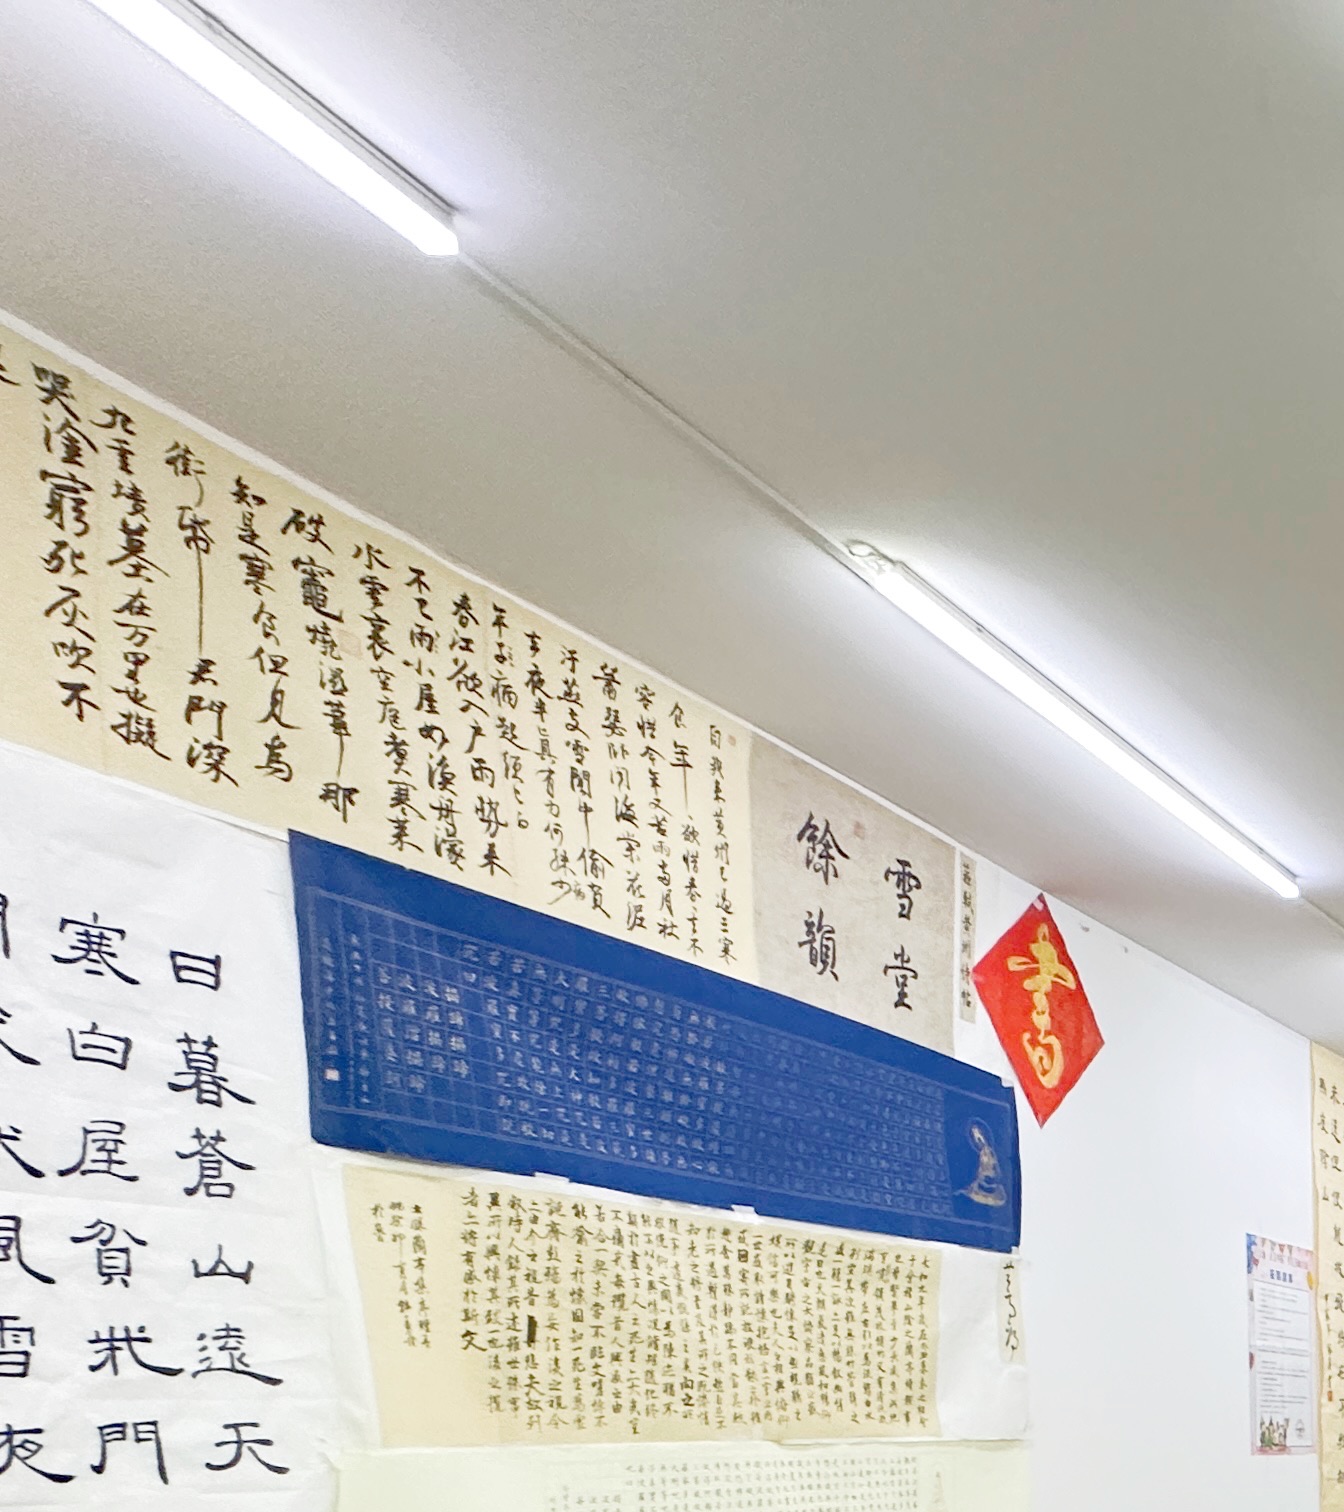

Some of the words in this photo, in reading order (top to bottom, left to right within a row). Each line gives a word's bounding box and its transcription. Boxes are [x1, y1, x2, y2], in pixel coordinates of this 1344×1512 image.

[883, 857, 923, 1012] 雪堂
[166, 949, 292, 1476] 日暮蒼山遠天
